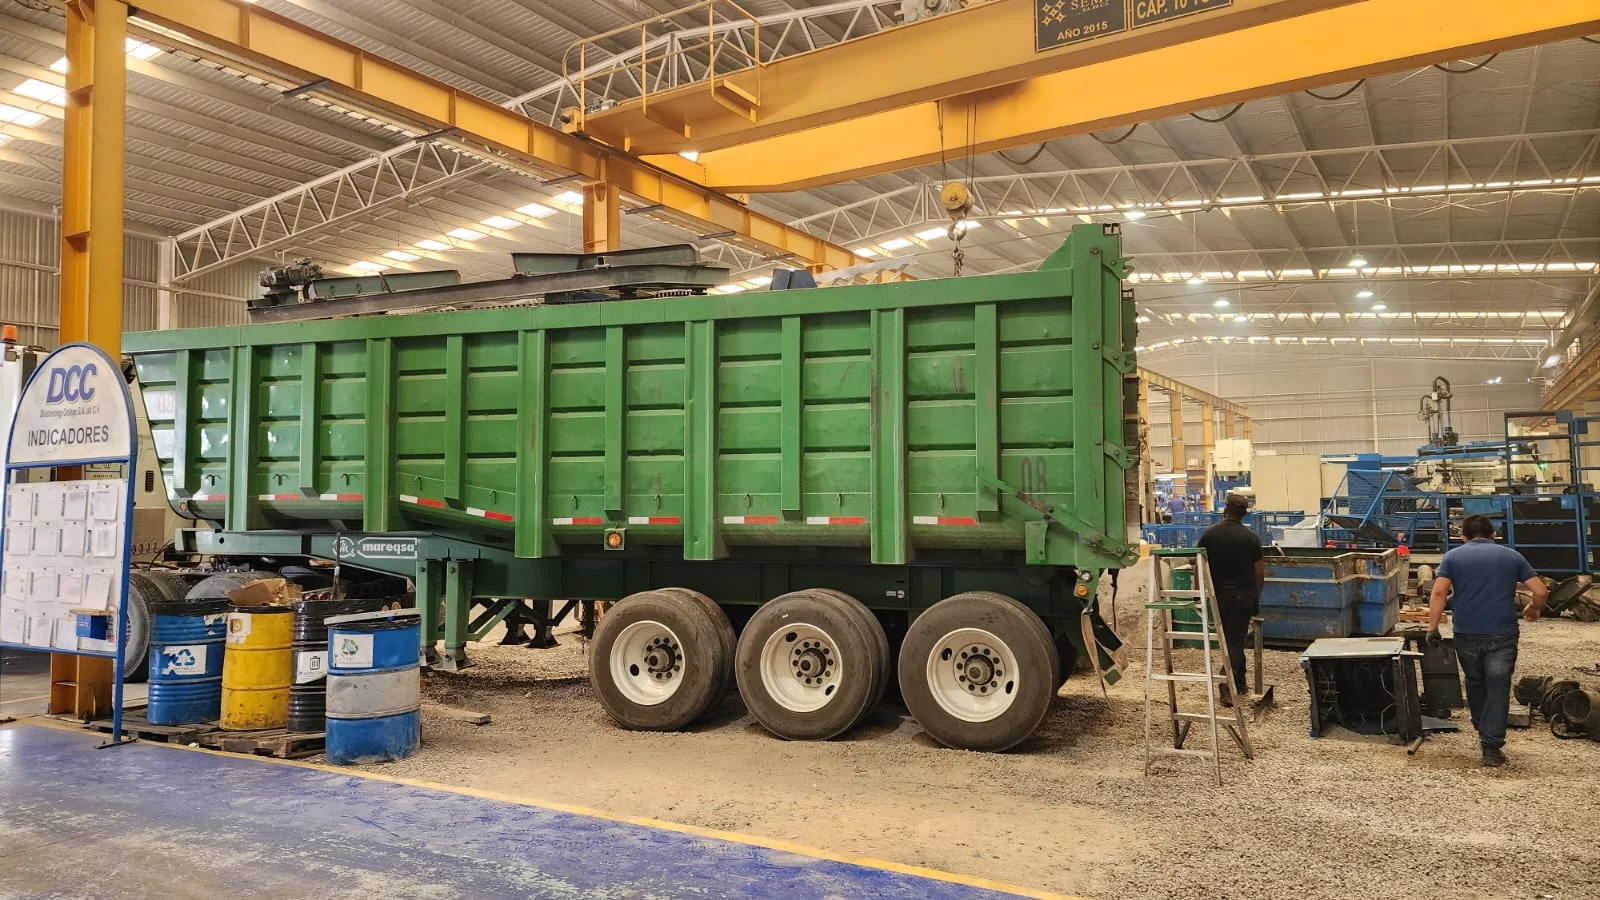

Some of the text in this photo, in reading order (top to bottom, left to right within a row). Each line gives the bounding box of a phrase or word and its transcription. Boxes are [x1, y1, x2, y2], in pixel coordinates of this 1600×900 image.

[1137, 0, 1168, 19] CAP.
[1057, 20, 1108, 41] AÑO 2015
[46, 363, 97, 403] DCC
[27, 425, 109, 447] INDICADORES
[362, 543, 415, 554] mareqsa
